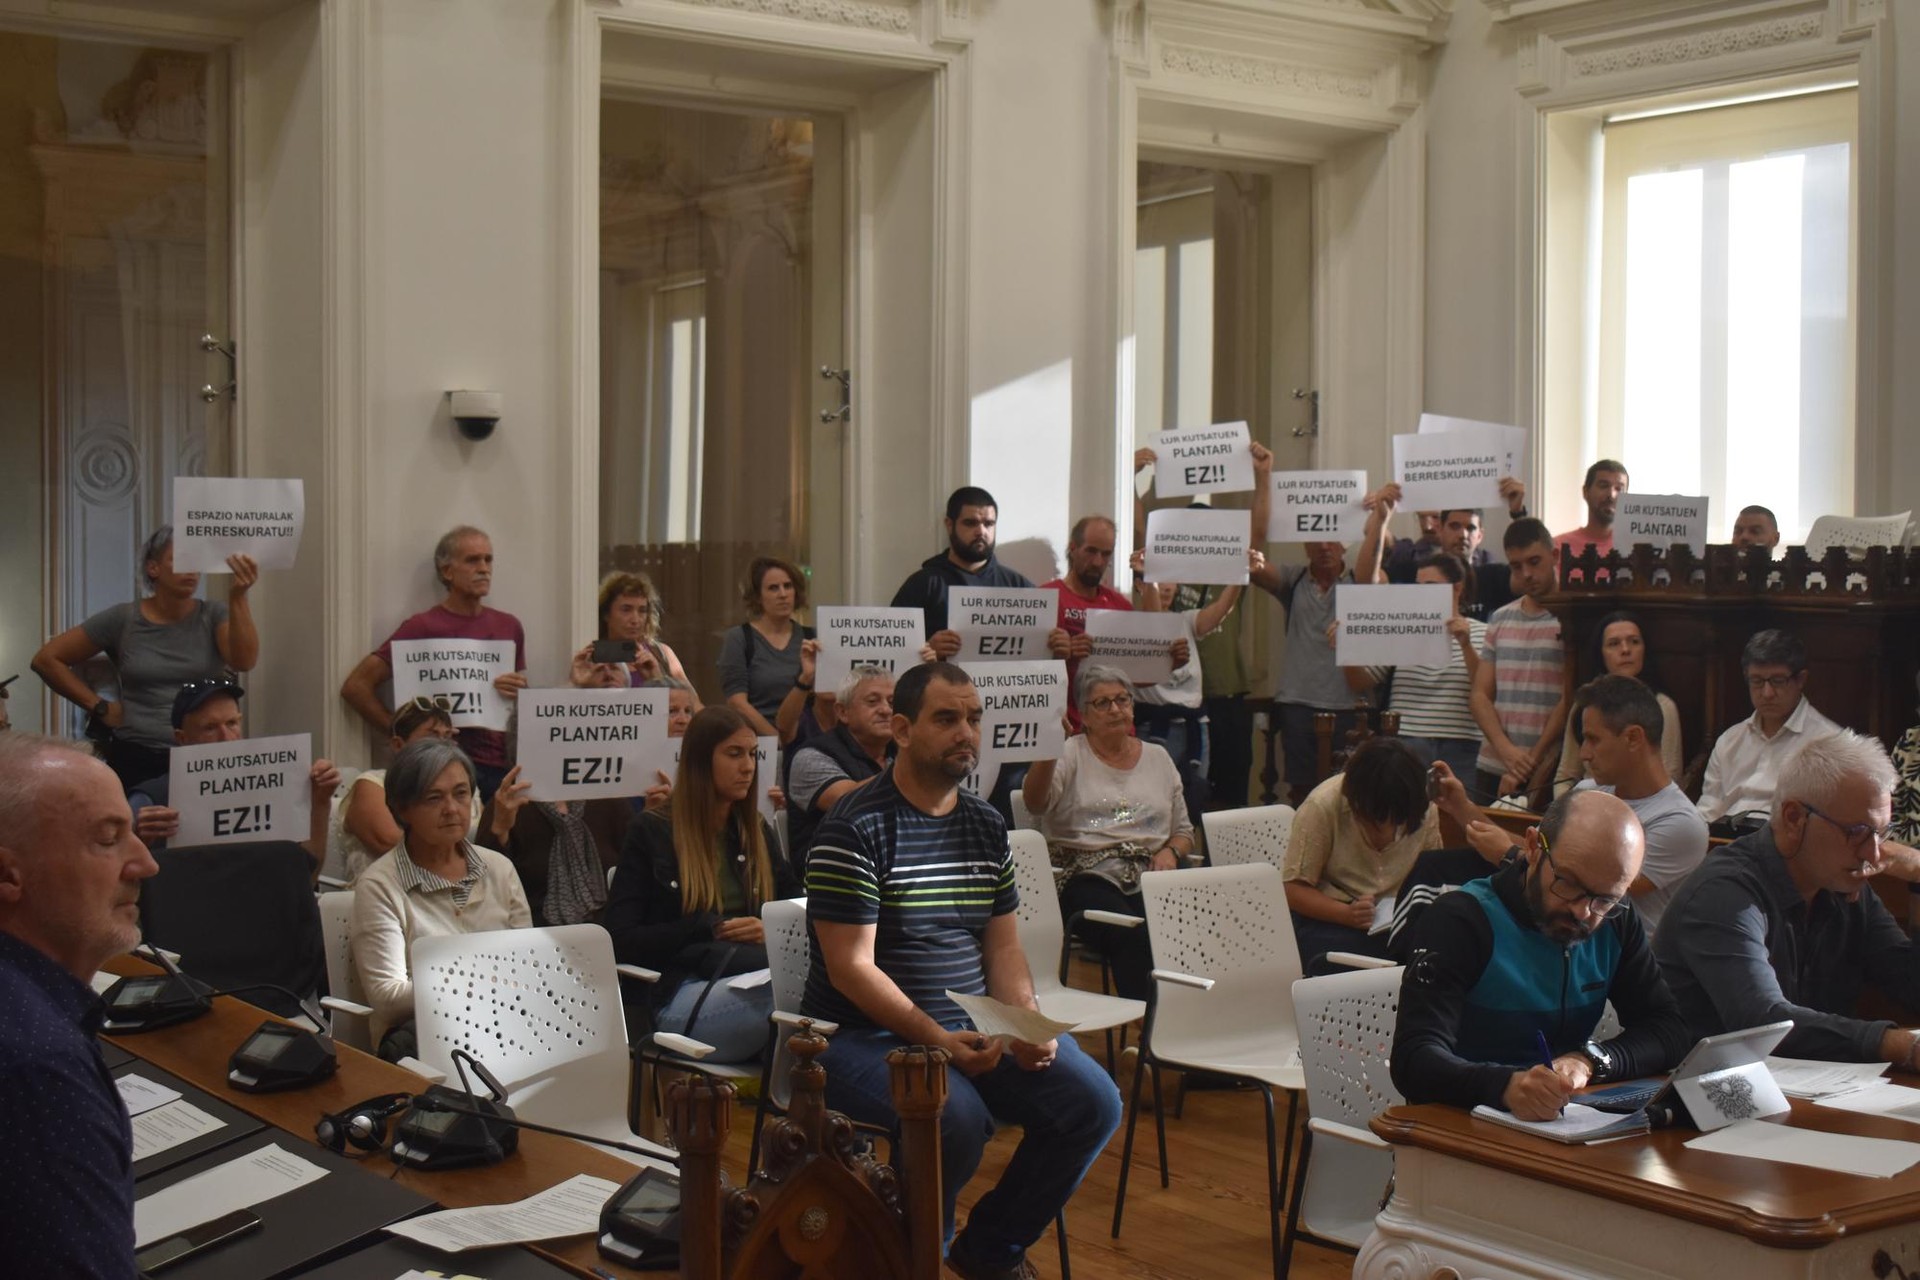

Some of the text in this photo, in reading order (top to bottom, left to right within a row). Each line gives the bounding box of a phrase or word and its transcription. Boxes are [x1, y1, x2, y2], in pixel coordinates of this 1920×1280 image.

[1160, 430, 1239, 445] LUR KUTSATUEN
[1172, 443, 1233, 459] PLANTARI
[1405, 456, 1496, 469] ESPAZIO NATURALAK
[1184, 464, 1226, 486] EZ!!
[1404, 468, 1498, 482] BERRESKURATU!!
[1277, 479, 1357, 490] LUR KUTSATUEN
[1286, 493, 1348, 505] PLANTARI
[187, 510, 294, 521] ESPAZIO NATURALAK
[1624, 504, 1698, 518] LUR KUTSATUEN
[1296, 514, 1339, 532] EZ!!
[1630, 521, 1687, 537] PLANTARI
[186, 525, 294, 538] BERRESKURATU!!
[1154, 533, 1241, 543] ESPAZIO NATURALAK
[1153, 544, 1242, 556] BERRESKURATU!!
[961, 597, 1048, 609] LUR KUTSATUEN
[830, 618, 915, 629] LUR KUTSATUEN
[971, 613, 1037, 627] PLANTARI
[1346, 611, 1442, 622] ESPAZIO NATURALAK
[1346, 625, 1443, 636] BERRESKURATU!!
[840, 635, 906, 648] PLANTARI
[978, 636, 1024, 655] EZ!!
[406, 650, 500, 663] LUR KUTSATUEN
[419, 667, 489, 682] PLANTARI
[973, 673, 1058, 688] LUR KUTSATUEN
[432, 692, 483, 714] Z!!
[984, 693, 1050, 710] PLANTARI
[535, 703, 654, 718] LUR KUTSATUEN
[549, 725, 639, 742] PLANTARI
[992, 722, 1038, 749] EZ!!
[186, 750, 298, 774] LUR KUTSATUEN
[561, 756, 623, 785] EZ!!
[199, 773, 284, 797] PLANTARI
[212, 804, 272, 836] EZ!!
